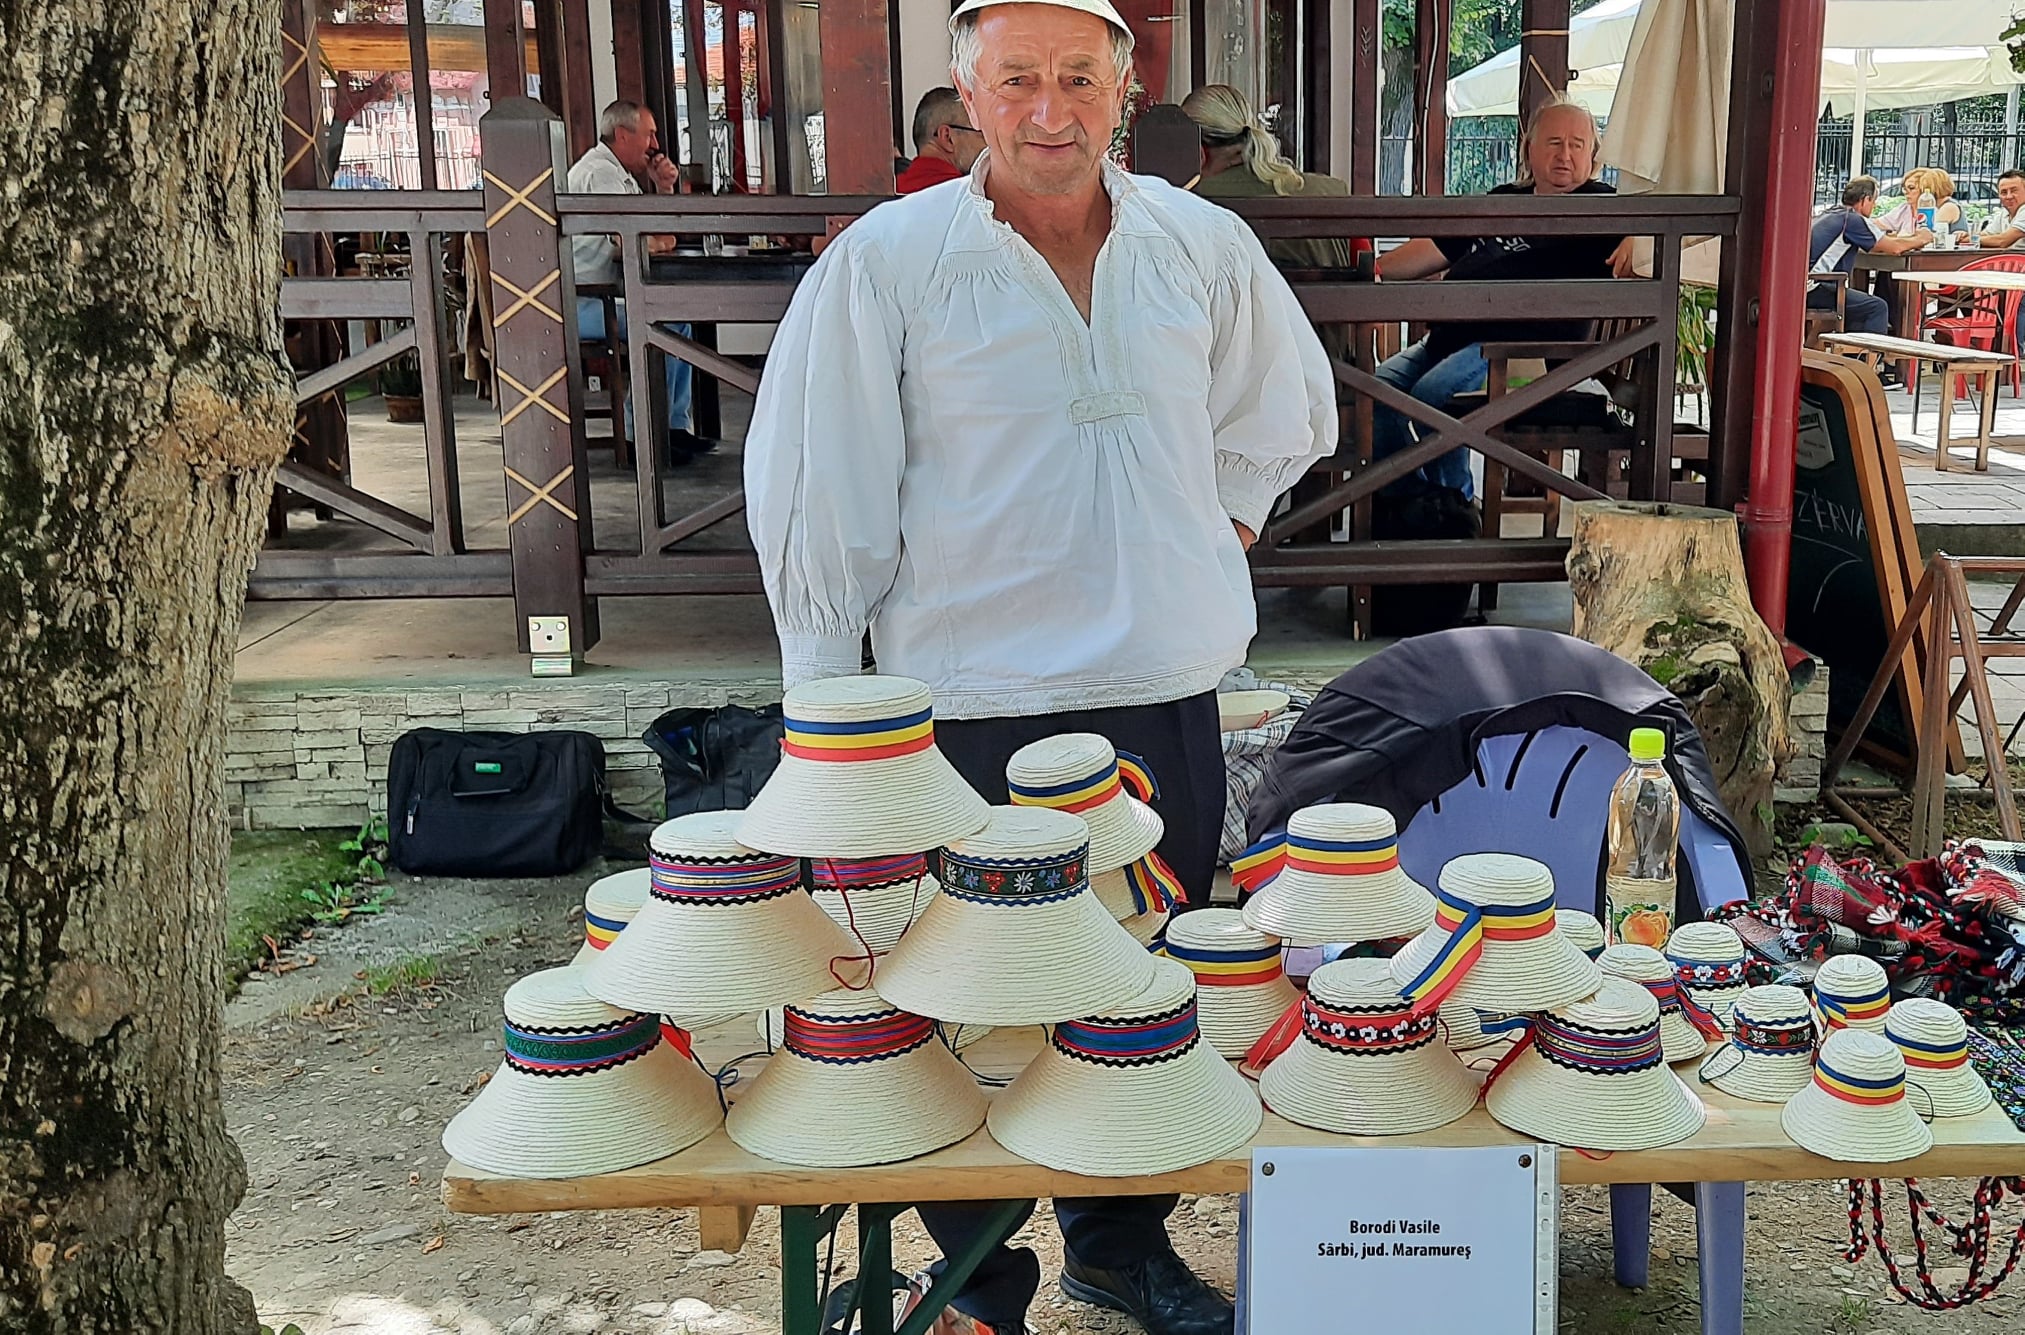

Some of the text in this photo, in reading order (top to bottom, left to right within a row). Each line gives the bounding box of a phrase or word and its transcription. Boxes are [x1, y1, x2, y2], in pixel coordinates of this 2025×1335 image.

[1349, 1219, 1441, 1234] Borodi Vasile
[1317, 1242, 1359, 1259] Sârbi,
[1361, 1242, 1389, 1260] jud.
